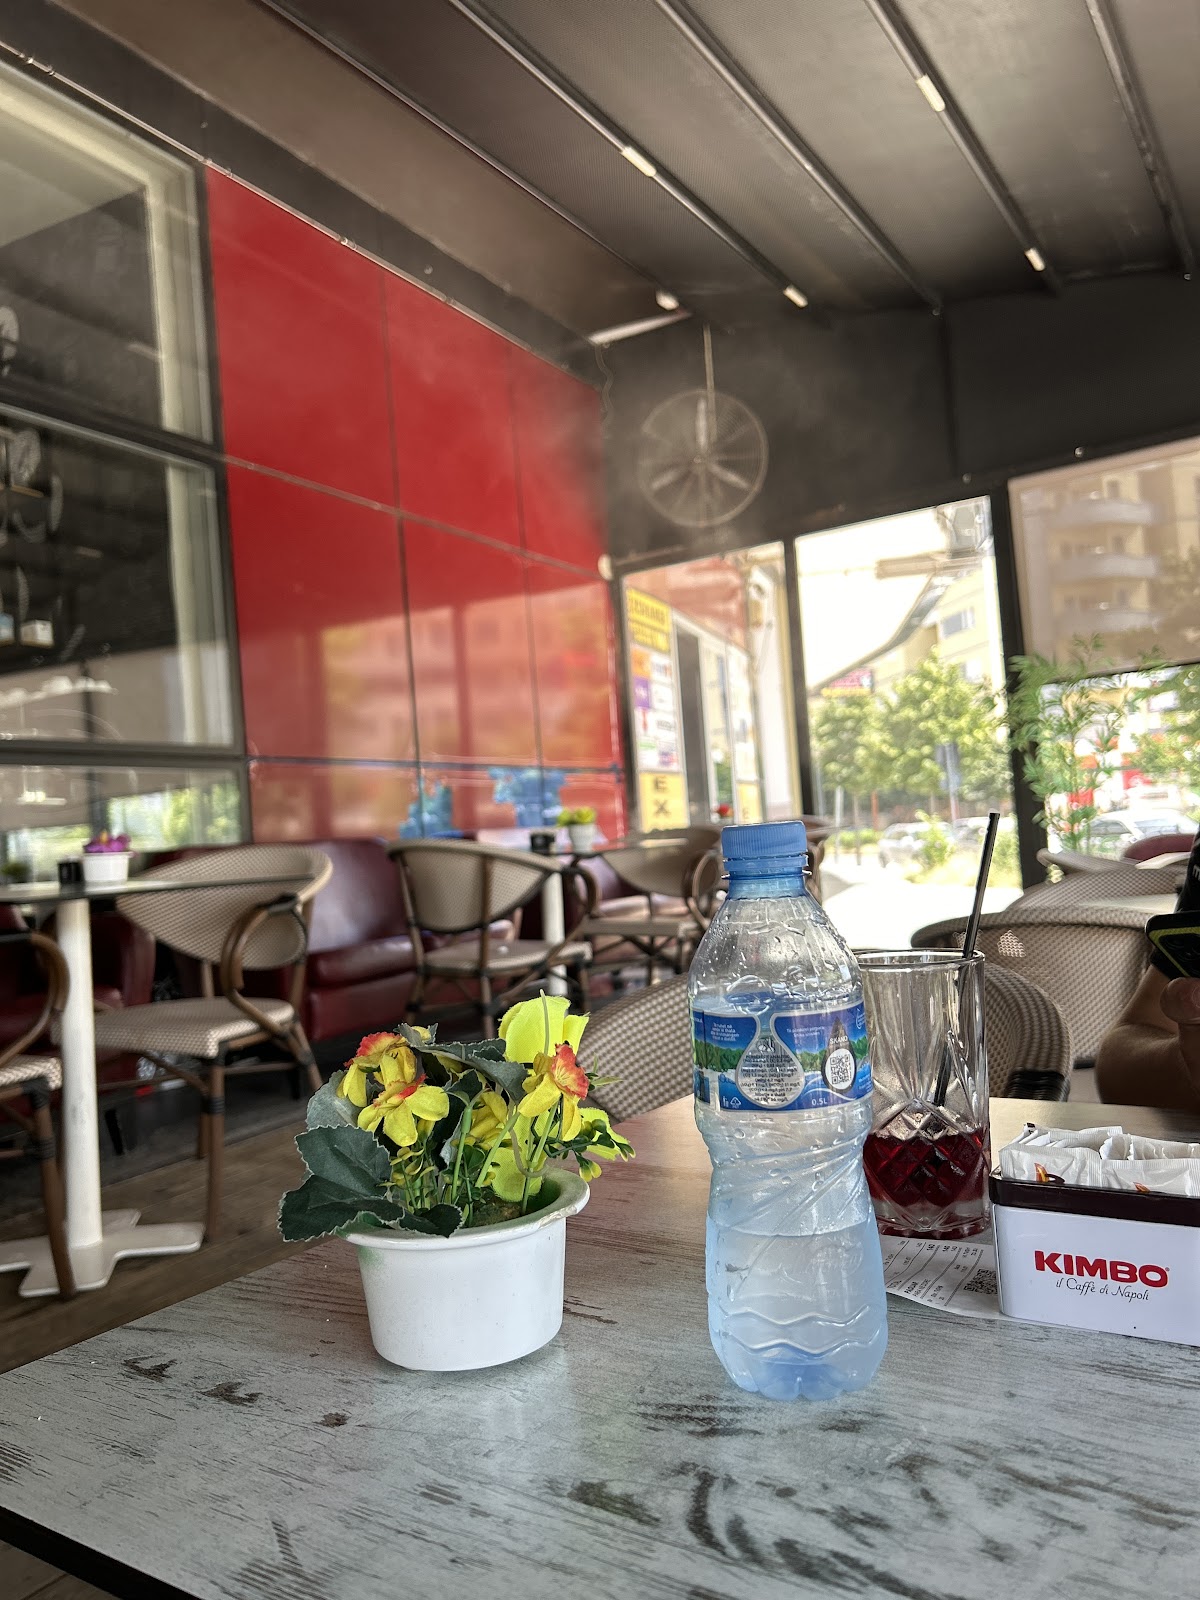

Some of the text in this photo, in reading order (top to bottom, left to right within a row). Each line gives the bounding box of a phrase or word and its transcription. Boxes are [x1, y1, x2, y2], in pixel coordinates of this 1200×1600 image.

[811, 1098, 827, 1106] 0.5L
[1034, 1250, 1168, 1288] KIMBO
[1056, 1277, 1149, 1303] il Caffè di Napoli
